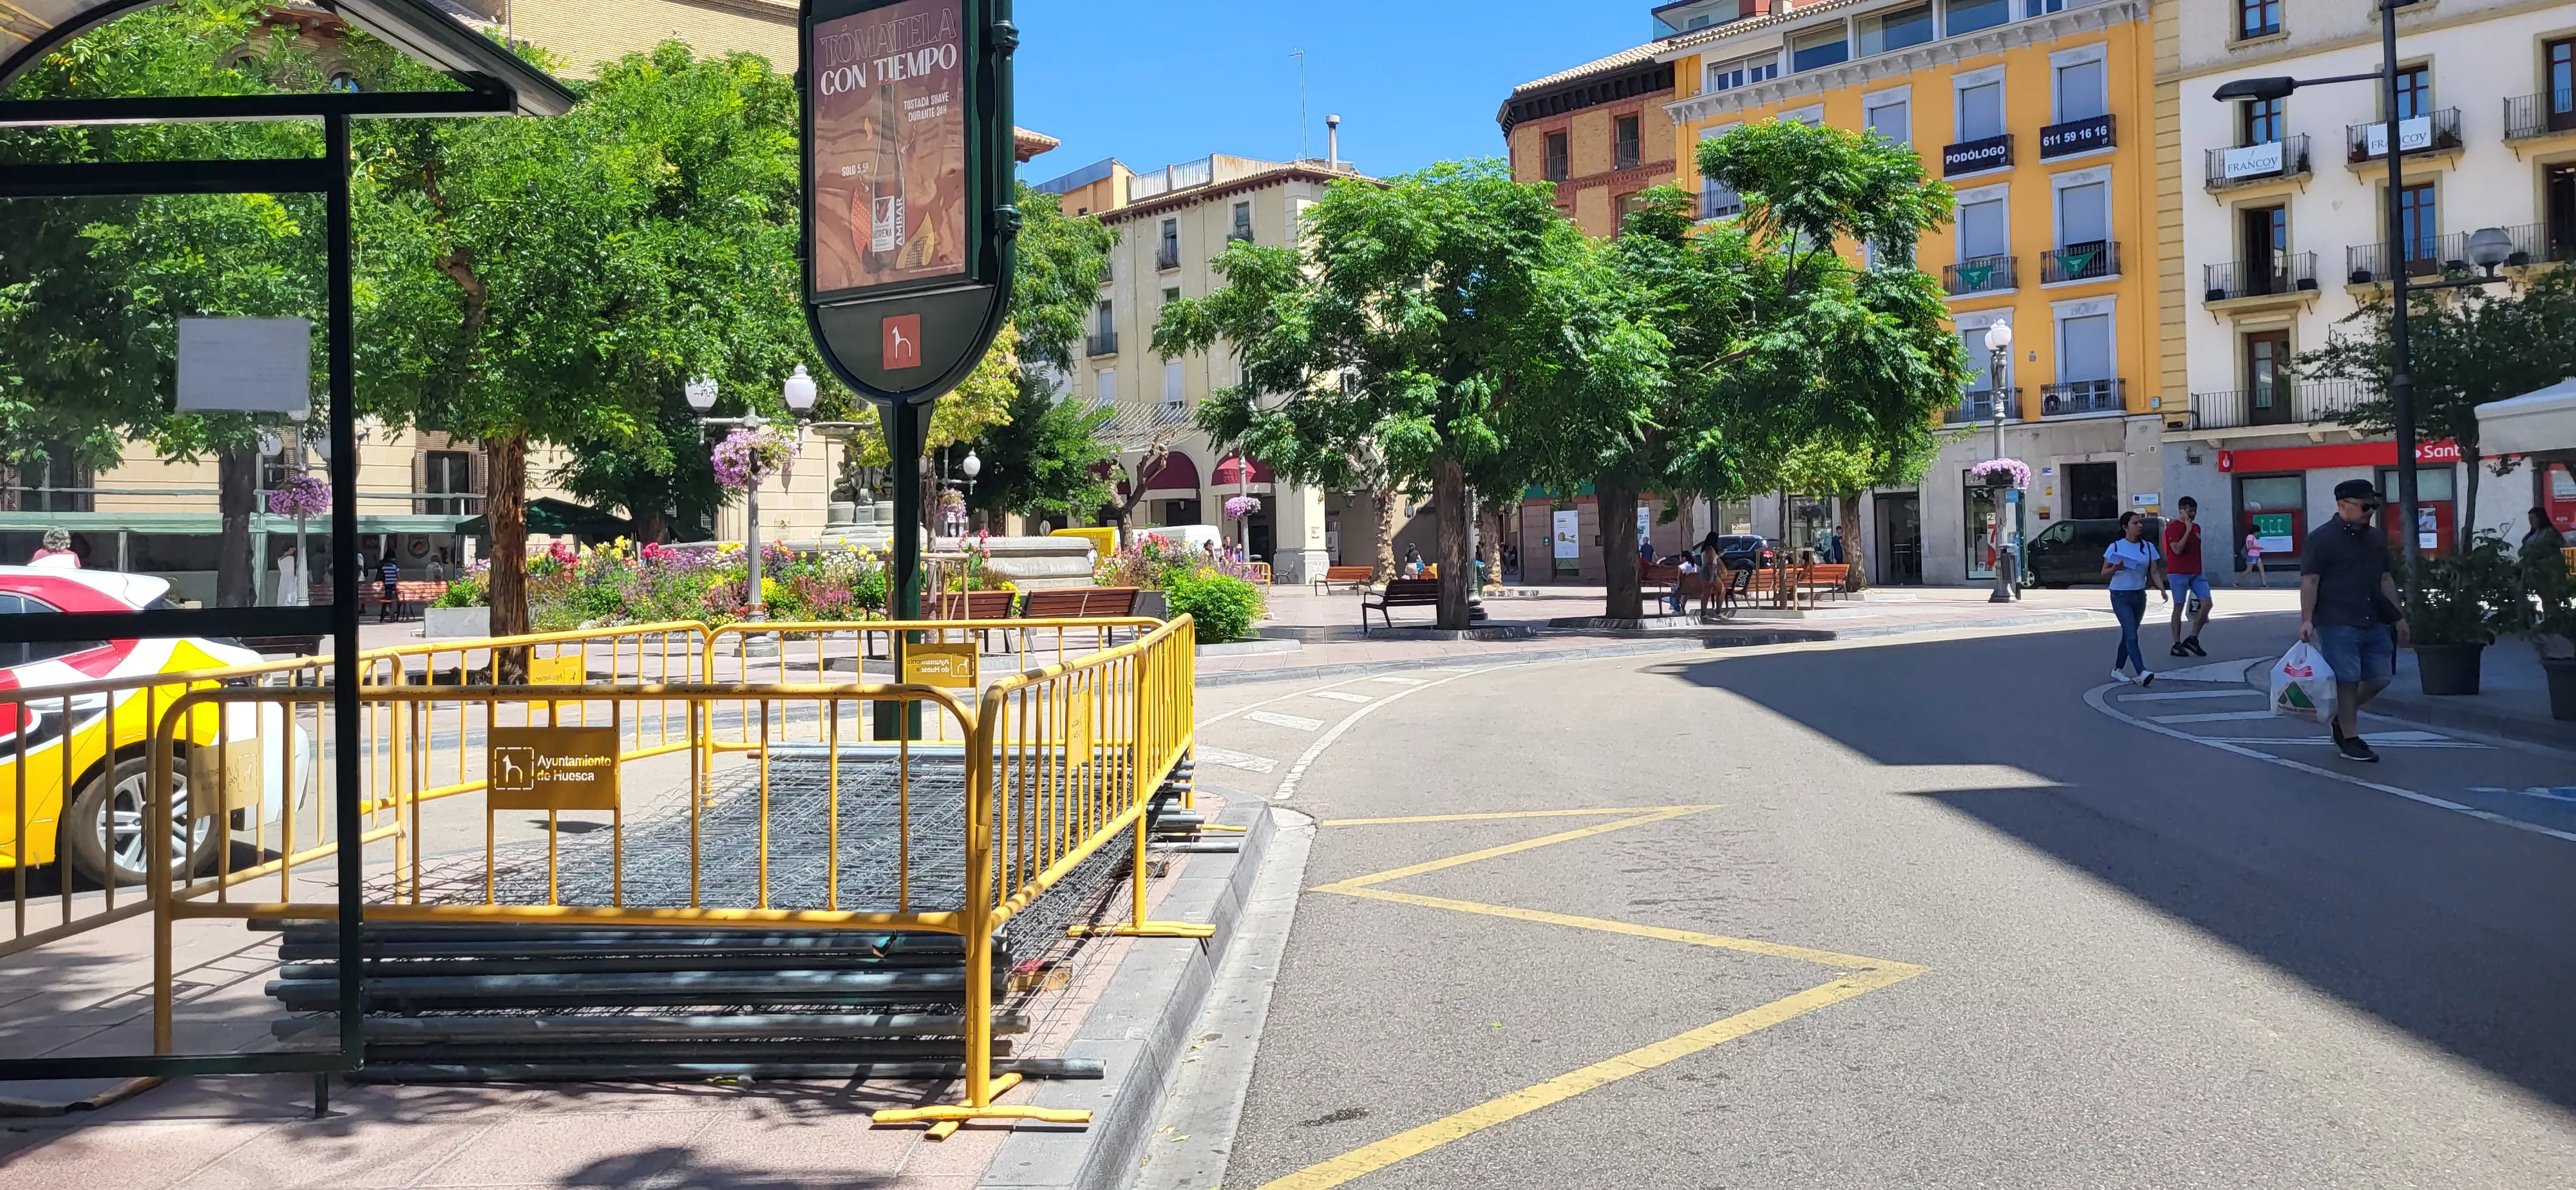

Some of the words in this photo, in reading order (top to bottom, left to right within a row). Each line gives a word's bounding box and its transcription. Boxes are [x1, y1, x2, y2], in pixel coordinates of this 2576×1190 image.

[820, 8, 957, 68] TÓMATELA
[820, 63, 867, 95] CON
[874, 43, 957, 81] TIEMPO
[903, 96, 929, 111] TOSTADA
[931, 91, 949, 104] SUAVE
[907, 108, 935, 122] DURANTE
[936, 104, 947, 117] 24H
[2043, 133, 2061, 147] 611
[2064, 131, 2076, 143] 59
[2079, 128, 2092, 140] 16
[2095, 125, 2107, 137] 16
[2371, 131, 2427, 149] FRCOY
[1946, 145, 2005, 165] PODÓLOGO
[2228, 156, 2278, 172] FRANCOY
[842, 164, 856, 177] SOLO
[2424, 444, 2461, 458] Sant
[537, 754, 612, 769] Ayuntamiento
[537, 770, 551, 781] de
[553, 770, 595, 782] Huesca
